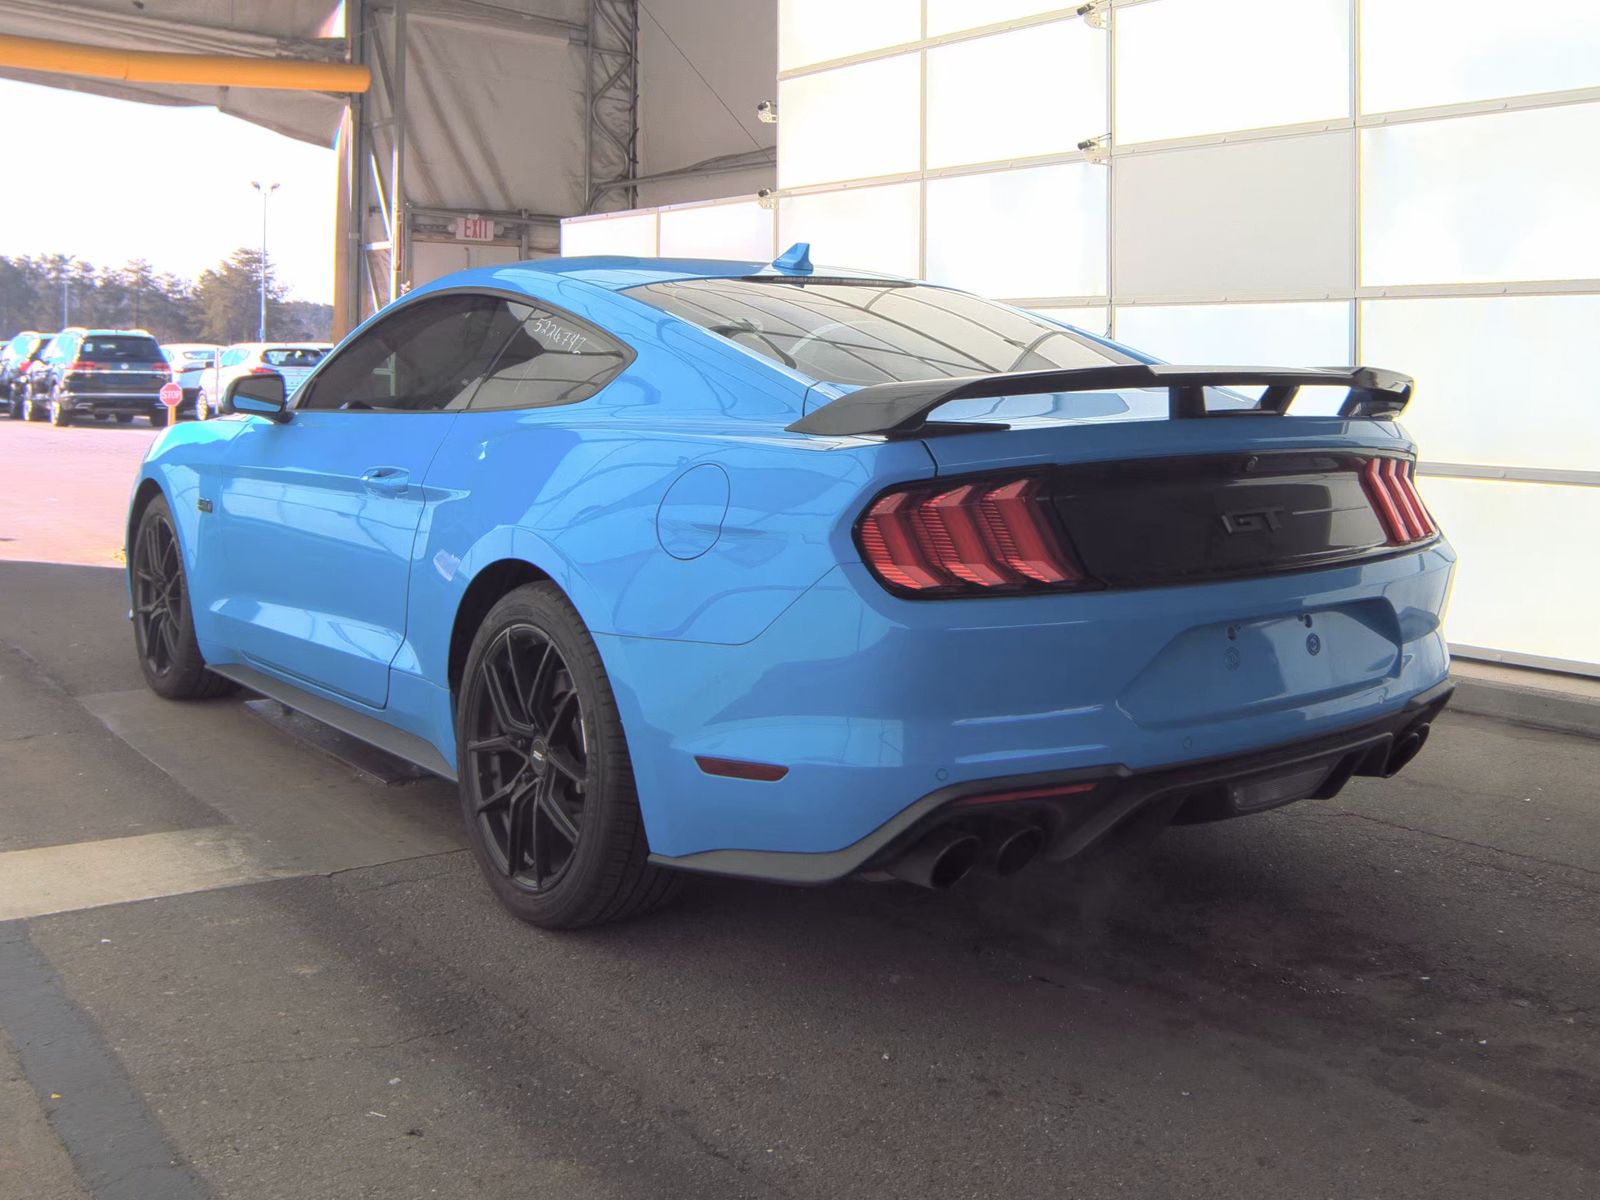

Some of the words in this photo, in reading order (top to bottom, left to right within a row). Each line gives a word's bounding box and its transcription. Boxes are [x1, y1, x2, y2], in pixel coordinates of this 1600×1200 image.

[464, 218, 488, 239] EXIT
[161, 390, 181, 399] STOP
[1221, 506, 1285, 534] GT
